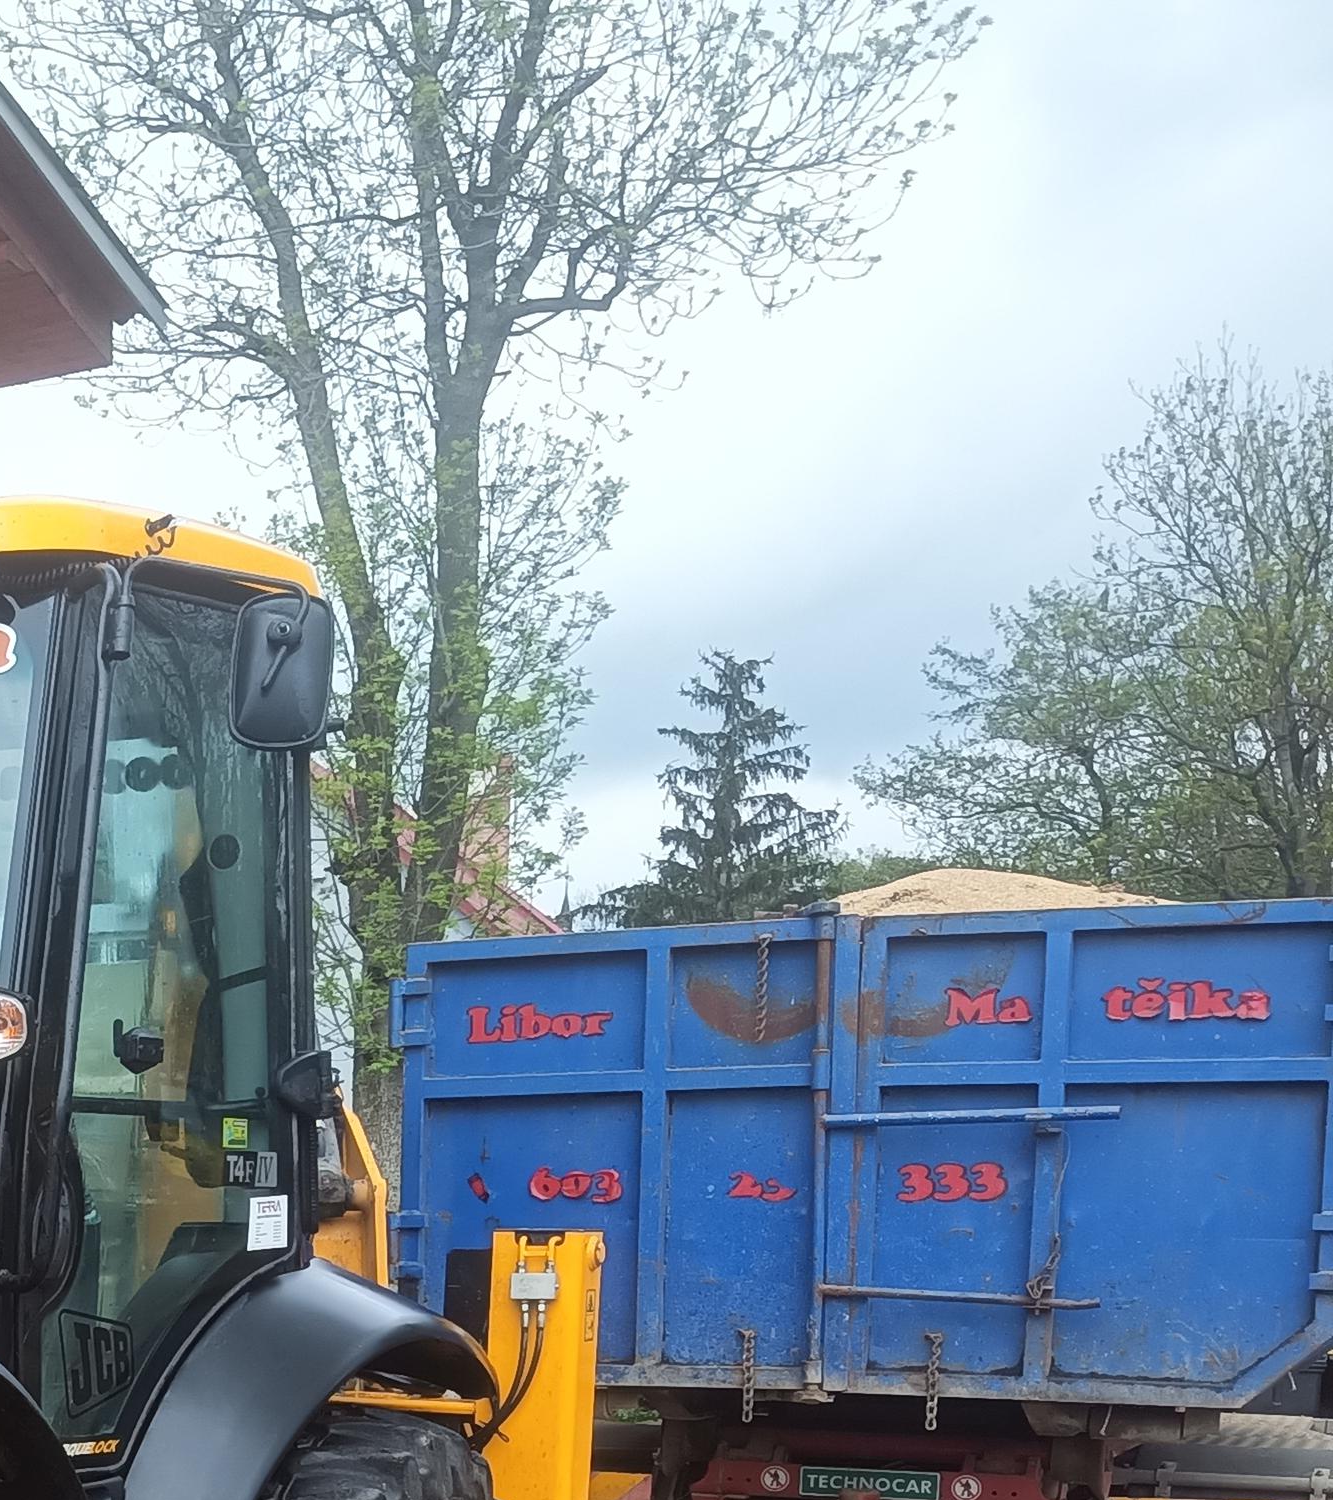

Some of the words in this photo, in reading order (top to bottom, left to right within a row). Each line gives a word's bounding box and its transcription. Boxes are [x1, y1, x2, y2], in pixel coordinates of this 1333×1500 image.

[466, 1003, 613, 1043] Libor
[944, 987, 1033, 1027] Ma
[528, 1165, 622, 1204] 603
[897, 1162, 1008, 1203] 333
[71, 1321, 130, 1406] JCB
[806, 1474, 933, 1494] TECHNOCAR
